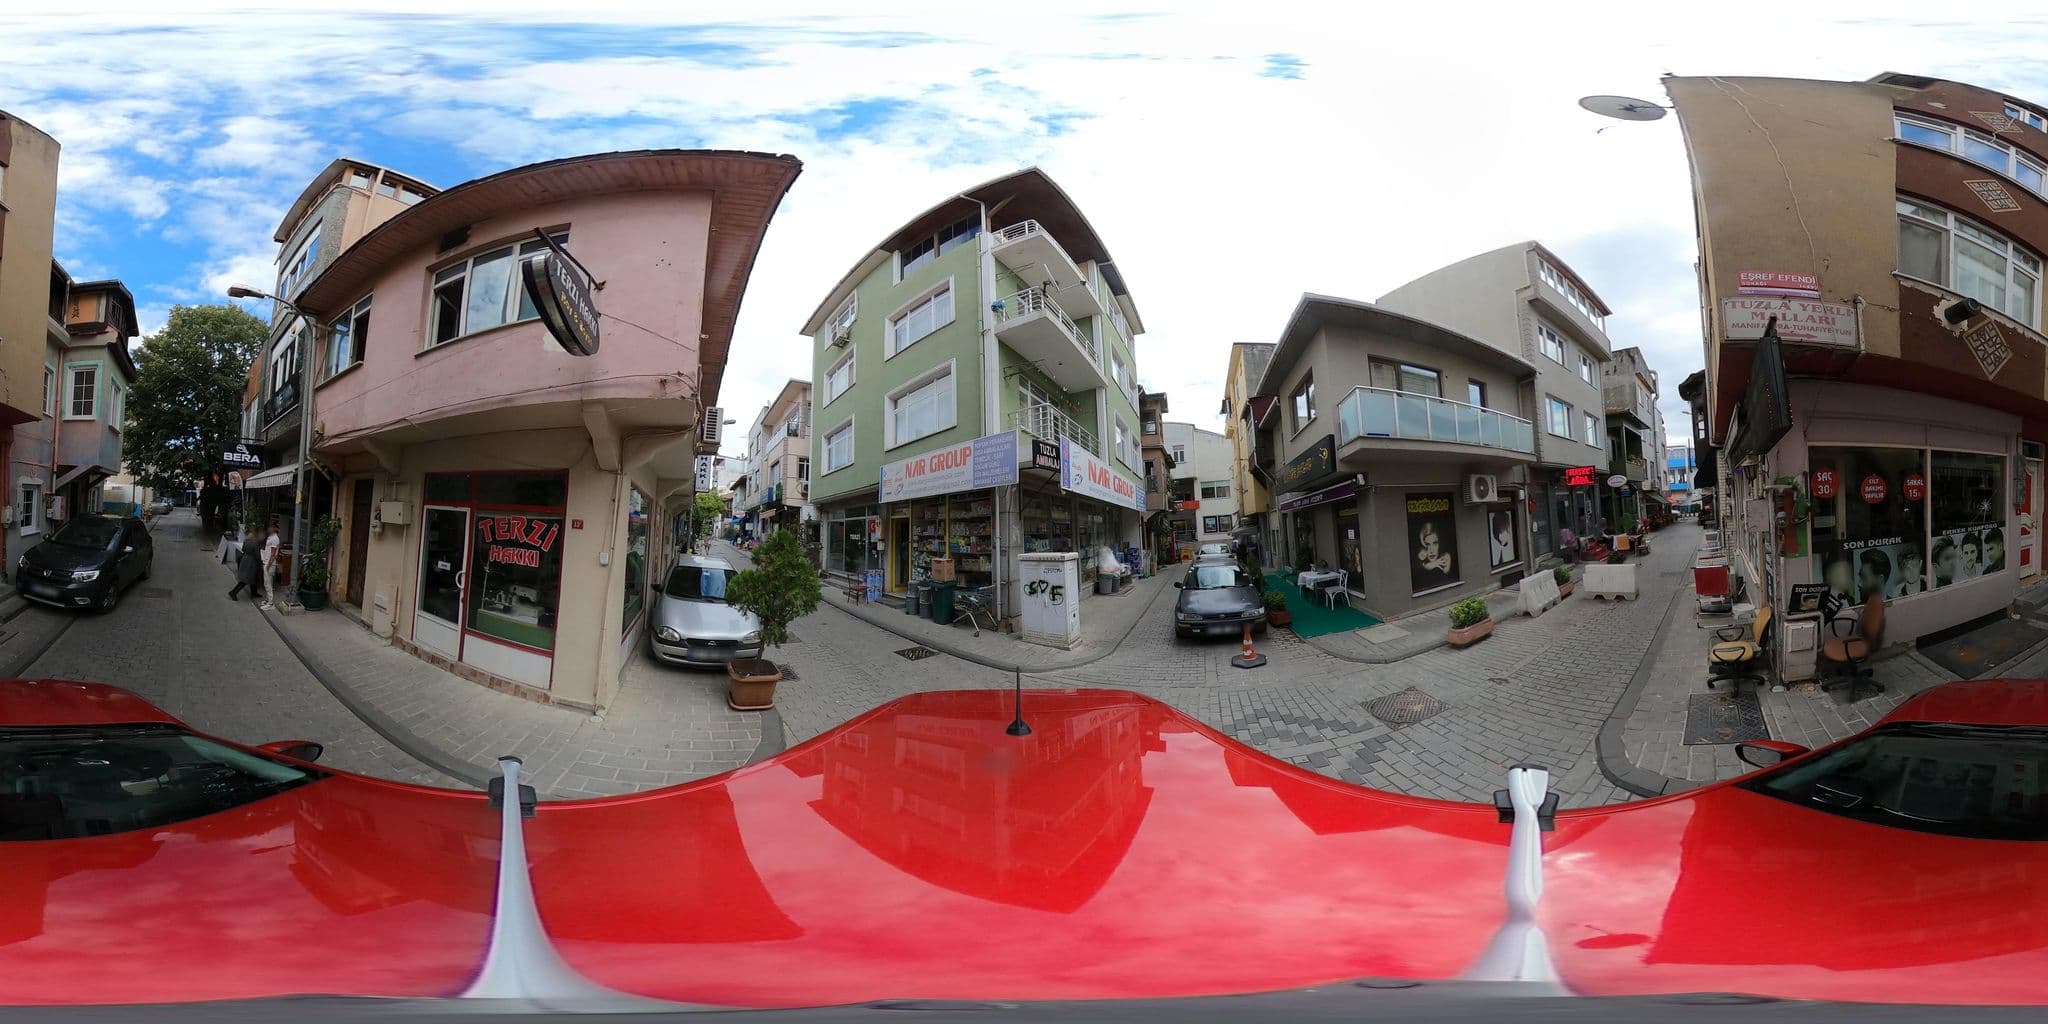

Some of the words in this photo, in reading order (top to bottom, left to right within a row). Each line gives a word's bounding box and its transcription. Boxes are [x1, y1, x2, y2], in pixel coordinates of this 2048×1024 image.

[1728, 300, 1791, 312] TUZLA
[1751, 311, 1837, 325] MALLARI
[223, 452, 260, 464] BERA
[1040, 443, 1056, 458] TUZLA
[905, 458, 926, 479] NAR
[929, 445, 972, 473] GROUP
[1087, 458, 1111, 490] NAR
[478, 516, 560, 552] TERZİ
[1843, 540, 1865, 550] SON
[1868, 536, 1902, 547] DURAK
[489, 545, 540, 568] HAKKI
